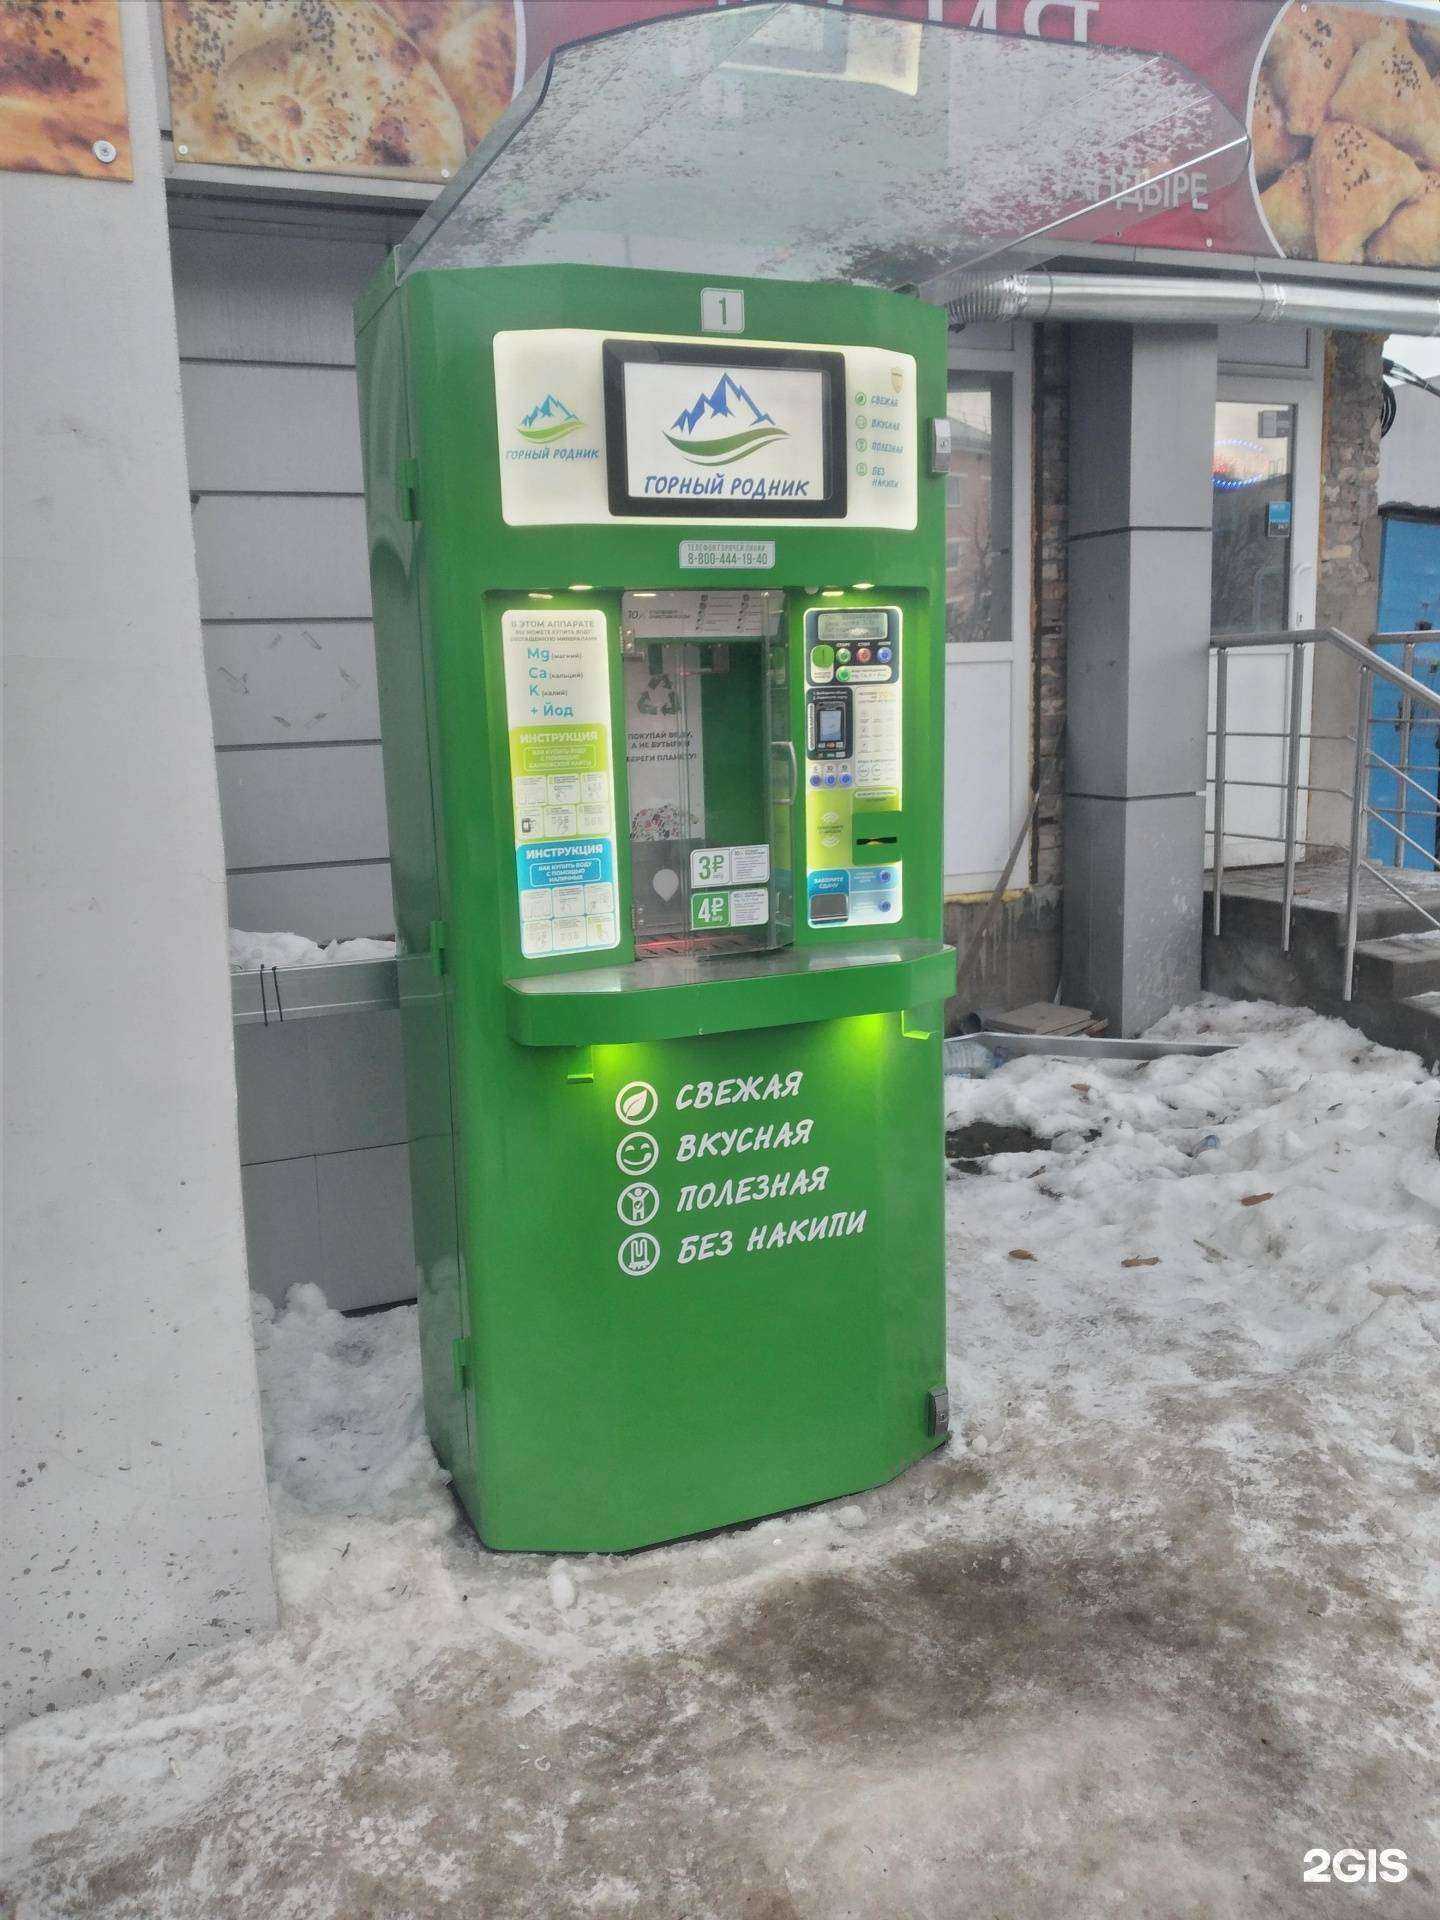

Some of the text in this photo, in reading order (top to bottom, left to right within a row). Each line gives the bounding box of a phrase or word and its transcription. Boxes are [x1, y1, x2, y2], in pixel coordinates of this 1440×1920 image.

[718, 297, 727, 325] 1
[506, 447, 600, 461] ГОРНЫЙ РОДНИК
[644, 473, 810, 499] ГОРНЫЙ РОДНИК
[519, 620, 545, 628] ЭТОМ
[547, 620, 594, 628] АППАРАТЕ
[527, 647, 549, 662] Mg
[528, 667, 547, 679] Ca
[543, 702, 575, 718] Йод
[520, 731, 598, 744] ИНСТРУКЦИЯ
[526, 844, 603, 860] ИНСТРУКЦИЯ
[675, 1071, 804, 1111] СВЕЖАЯ
[676, 1118, 814, 1163] ВКУСНАЯ
[676, 1165, 830, 1213] ПОЛЕЗНАЯ
[677, 1209, 867, 1264] БЕЗ НАКИПИ
